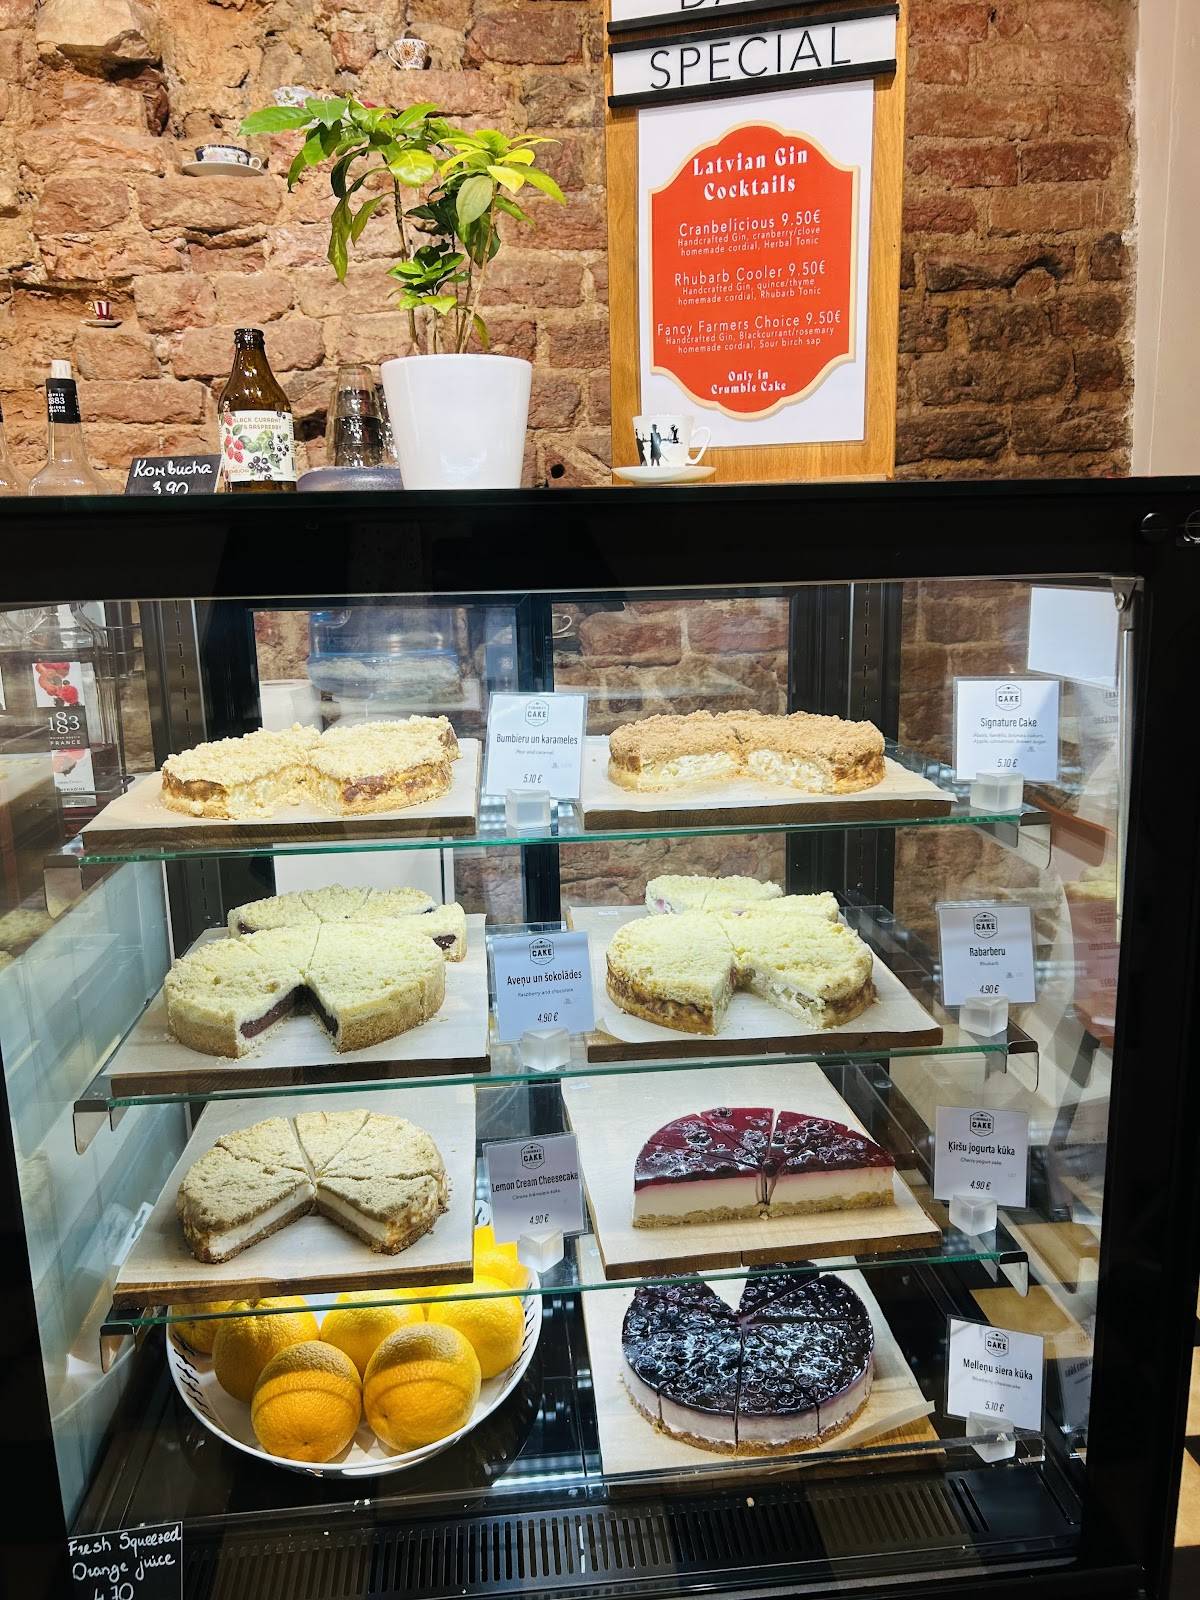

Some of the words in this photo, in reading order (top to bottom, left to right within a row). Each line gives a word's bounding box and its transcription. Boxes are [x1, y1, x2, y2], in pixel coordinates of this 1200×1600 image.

[650, 26, 851, 90] SPECIAL
[693, 153, 766, 176] Latvian
[775, 148, 808, 166] Gin
[703, 175, 796, 201] Cocktails
[679, 218, 775, 237] Cranbelicious
[781, 209, 821, 226] 9.50€
[677, 233, 729, 247] Handcrafted
[752, 226, 821, 241] cranberry/clove
[680, 244, 725, 256] homemade
[764, 236, 792, 248] Herbal
[796, 236, 819, 246] Tonic
[674, 269, 730, 287] Rhubarb
[736, 265, 783, 281] Cooler
[788, 260, 826, 276] 9.50€
[682, 283, 733, 296] Handcrafted
[757, 277, 815, 291] quince/thyme
[678, 296, 722, 306] homemade
[760, 288, 795, 299] Rhubarb
[799, 286, 821, 295] Tonic
[657, 323, 693, 337] Fancy
[699, 319, 749, 334] Farmers
[754, 314, 801, 329] Choice
[806, 309, 842, 325] 9.50€
[665, 334, 716, 345] Handcrafted
[739, 326, 834, 340] Blackcurrant/rosemary
[678, 344, 722, 354] homemade
[759, 338, 778, 349] Sour
[781, 336, 803, 347] birch
[806, 338, 821, 346] sap
[728, 370, 753, 383] Only
[711, 381, 756, 395] Crumble
[760, 379, 787, 393] Cake
[133, 459, 213, 478] Kombucha
[998, 695, 1020, 703] CAKE
[980, 717, 1017, 729] Signature
[1018, 717, 1037, 727] Cake
[496, 733, 530, 743] Bumbieru
[541, 734, 578, 745] karameles
[531, 948, 553, 957] CAKE
[969, 947, 1006, 957] Rabarberu
[507, 975, 531, 987] Aveņu
[533, 974, 543, 982] un
[544, 968, 582, 982] šokolādes
[980, 985, 993, 994] 4.90
[537, 1012, 552, 1023] 4.90
[971, 1121, 992, 1129] CAKE
[523, 1153, 543, 1162] CAKE
[948, 1141, 967, 1153] Ķiršu
[968, 1142, 996, 1155] jogurta
[997, 1144, 1016, 1156] kūka
[491, 1182, 515, 1193] Lemon
[515, 1178, 538, 1189] Cream
[538, 1171, 579, 1185] Cheesecake
[970, 1180, 985, 1190] 4.90
[529, 1213, 544, 1225] 4.90
[986, 1340, 1008, 1350] CAKE
[963, 1358, 993, 1375] Melleņu
[994, 1364, 1013, 1377] siera
[1014, 1367, 1034, 1381] kūka
[984, 1400, 999, 1412] 5.10
[68, 1537, 112, 1557] Fresh
[119, 1525, 182, 1558] Squeezed
[72, 1562, 129, 1583] Orange
[135, 1553, 176, 1581] juice
